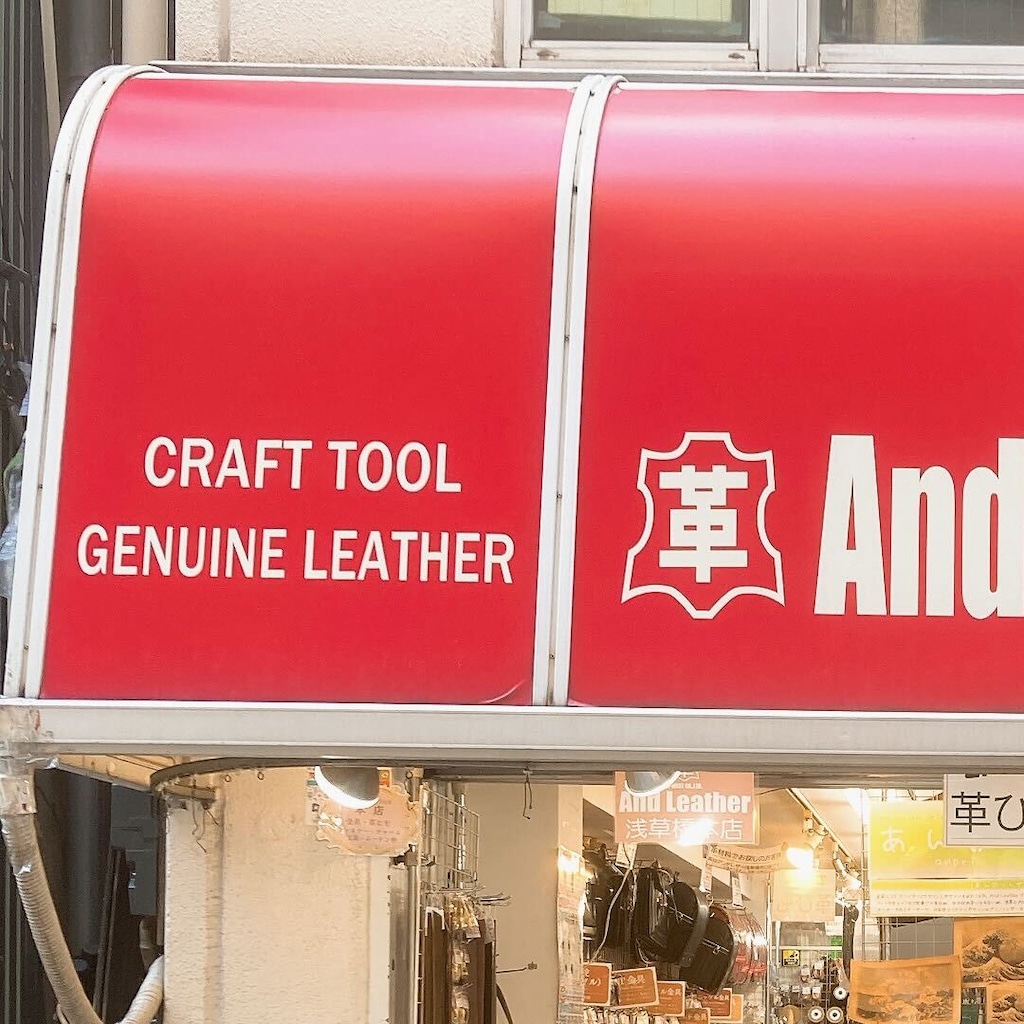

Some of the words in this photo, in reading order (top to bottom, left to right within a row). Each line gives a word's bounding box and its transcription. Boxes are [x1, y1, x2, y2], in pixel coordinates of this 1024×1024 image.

[144, 435, 312, 491] CRAFT
[328, 440, 462, 493] TOOL
[659, 465, 748, 583] 革
[77, 524, 287, 580] GENUINE
[304, 529, 515, 584] LEATHER
[666, 790, 752, 813] Leather
